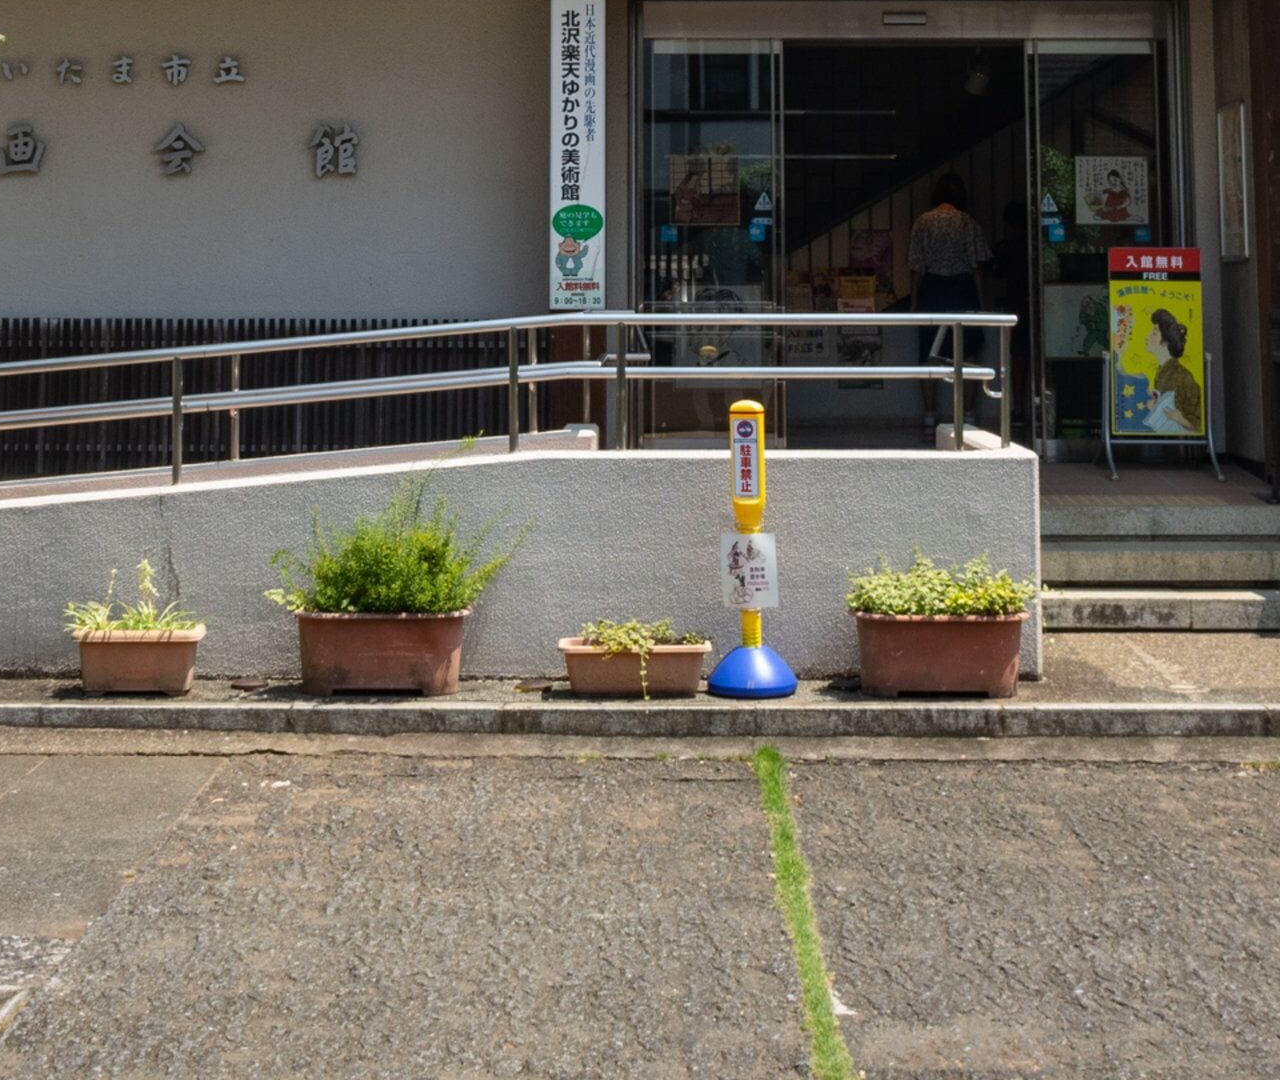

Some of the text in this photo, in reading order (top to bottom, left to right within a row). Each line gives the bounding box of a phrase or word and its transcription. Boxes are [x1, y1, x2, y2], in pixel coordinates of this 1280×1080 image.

[561, 10, 580, 201] 北沢楽天ゆかりの美術館
[1125, 255, 1184, 269] 入館無料
[1142, 272, 1169, 281] FREE
[740, 445, 753, 493] 駐車禁止
